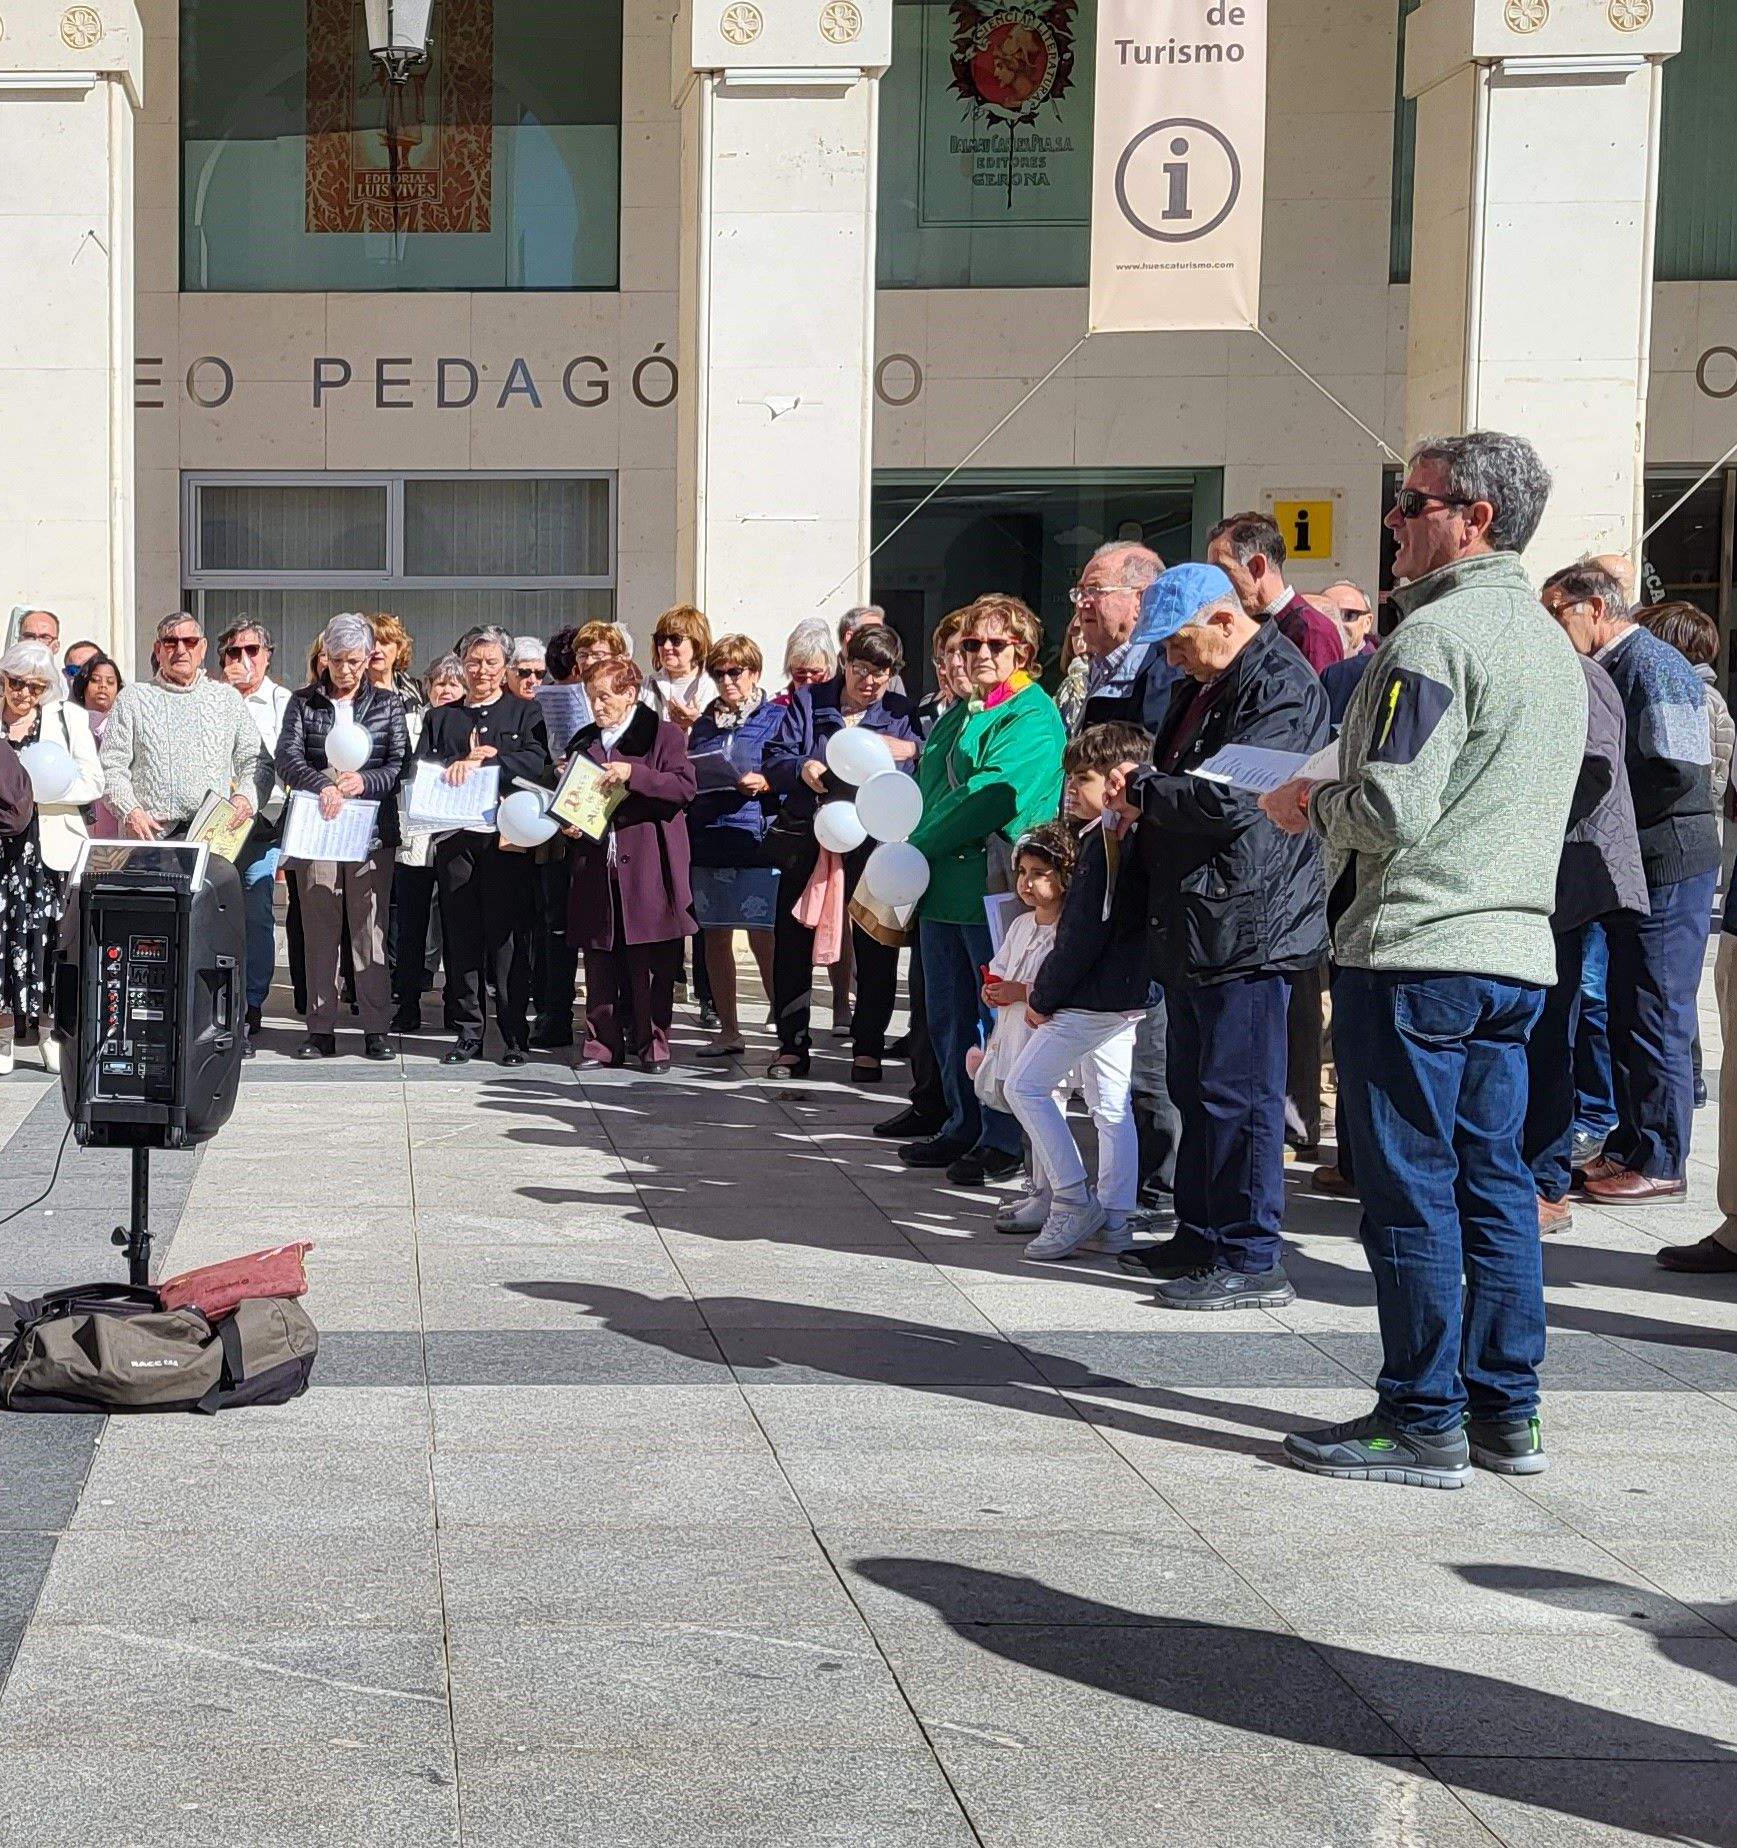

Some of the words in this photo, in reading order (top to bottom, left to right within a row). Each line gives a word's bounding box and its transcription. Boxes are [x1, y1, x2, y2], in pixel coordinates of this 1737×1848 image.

[1206, 0, 1246, 26] de
[1114, 38, 1245, 65] Turismo
[365, 173, 429, 184] EDITORIAL
[972, 172, 1051, 187] GERONA
[358, 184, 390, 198] LUIS
[394, 184, 436, 198] VIVES
[1115, 261, 1235, 271] www.huescaturismo.com
